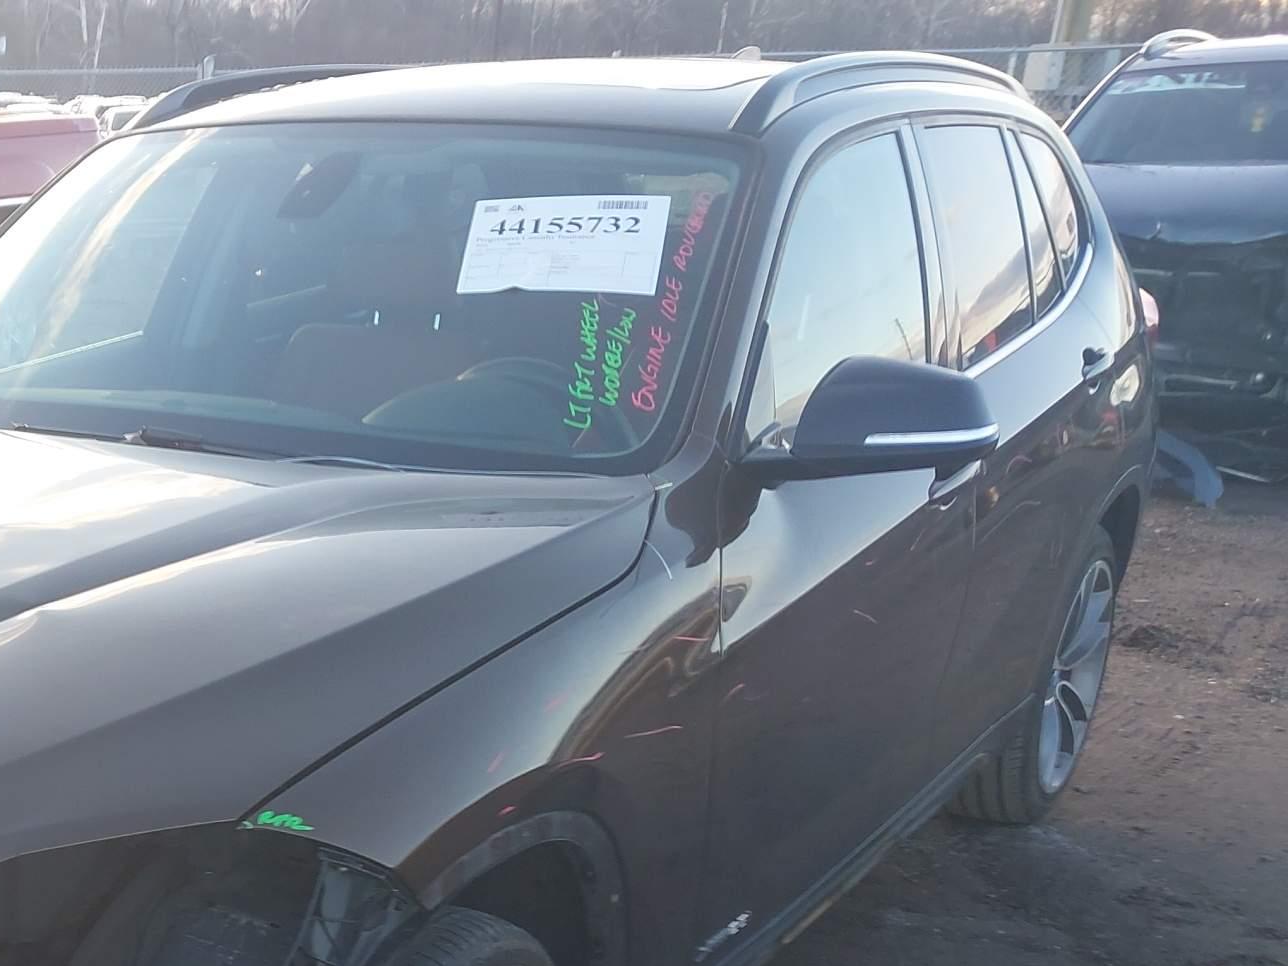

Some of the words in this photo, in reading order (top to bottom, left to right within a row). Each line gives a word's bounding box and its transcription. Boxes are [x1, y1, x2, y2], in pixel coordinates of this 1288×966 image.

[490, 216, 641, 235] 44155732
[632, 326, 671, 411] ENGINE
[660, 276, 683, 322] IDLE
